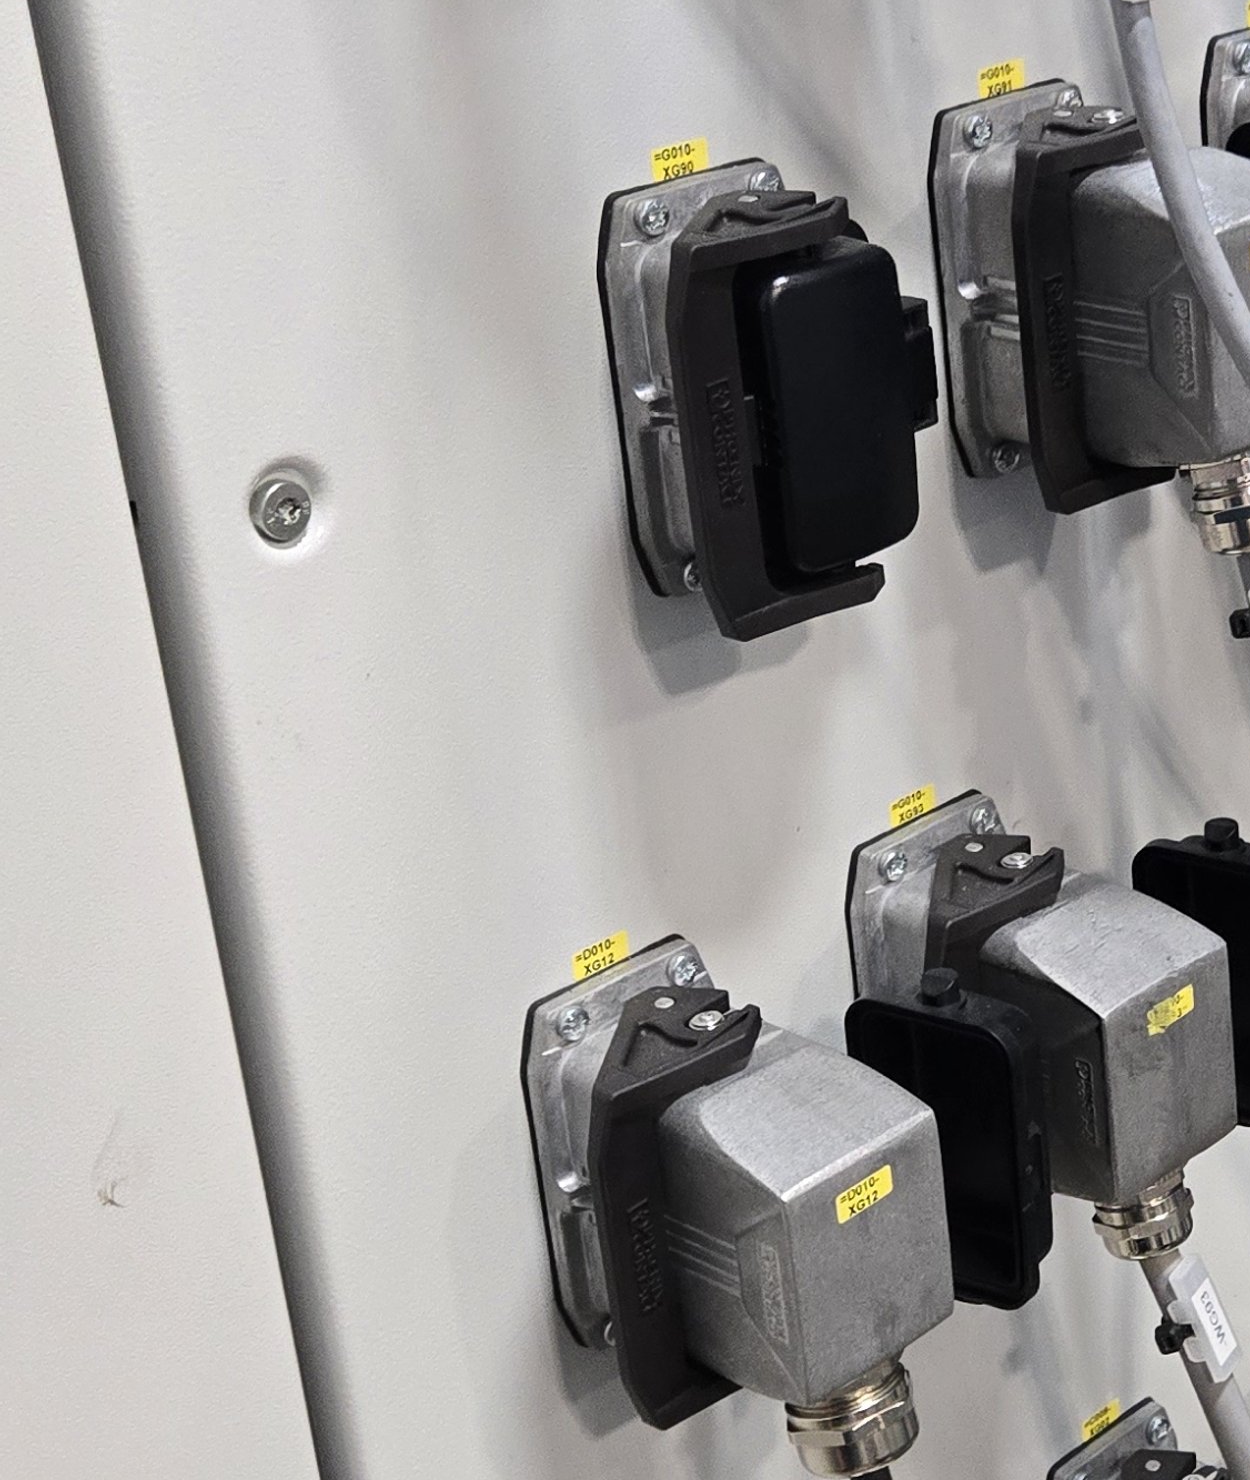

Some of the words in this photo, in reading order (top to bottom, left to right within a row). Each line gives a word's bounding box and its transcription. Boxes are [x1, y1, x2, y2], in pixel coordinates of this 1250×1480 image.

[981, 63, 1015, 82] =G010-
[987, 80, 1013, 98] XG91
[654, 143, 697, 163] =G010-
[663, 161, 695, 180] XG90
[892, 790, 926, 812] =G010-
[898, 803, 925, 824] XG93
[575, 938, 616, 964] =D010-
[583, 953, 616, 977] XG12
[839, 1176, 882, 1205] =D010-
[848, 1190, 881, 1218] XG12
[1201, 1290, 1227, 1347] -WG93
